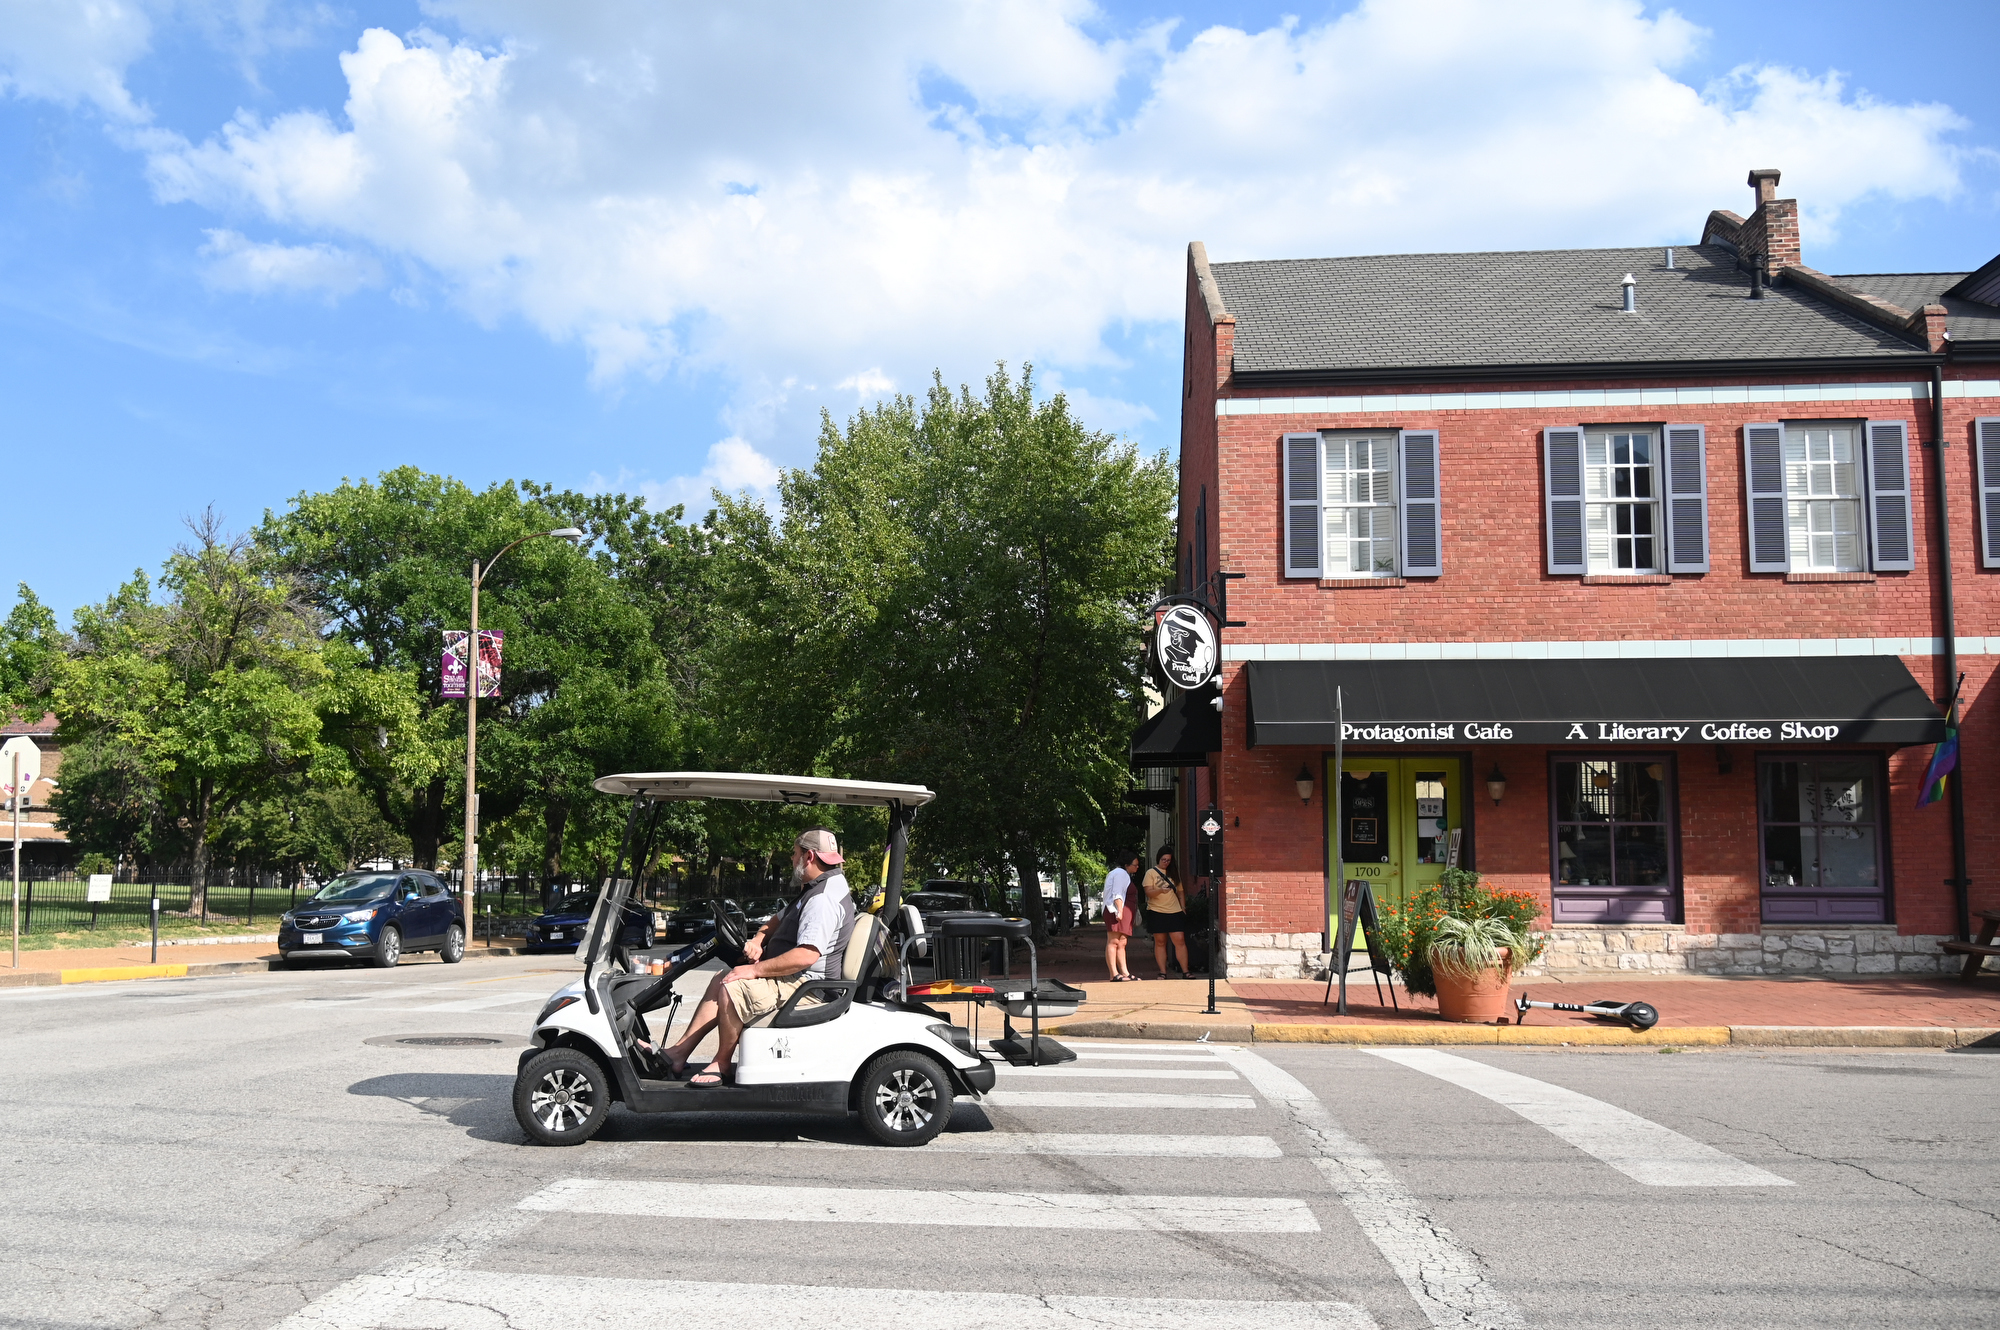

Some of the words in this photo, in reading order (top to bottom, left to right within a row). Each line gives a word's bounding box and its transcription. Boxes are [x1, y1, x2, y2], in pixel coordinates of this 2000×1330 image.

[1182, 673, 1197, 681] Cafe
[1341, 723, 1455, 742] Protagonist
[1464, 723, 1513, 740] Cafe
[1565, 723, 1589, 739] A
[1598, 722, 1690, 741] Literary
[1701, 723, 1772, 740] Coffee
[1780, 722, 1839, 741] Shop
[1355, 867, 1380, 877] 1700
[768, 1086, 825, 1101] YAMAHA
